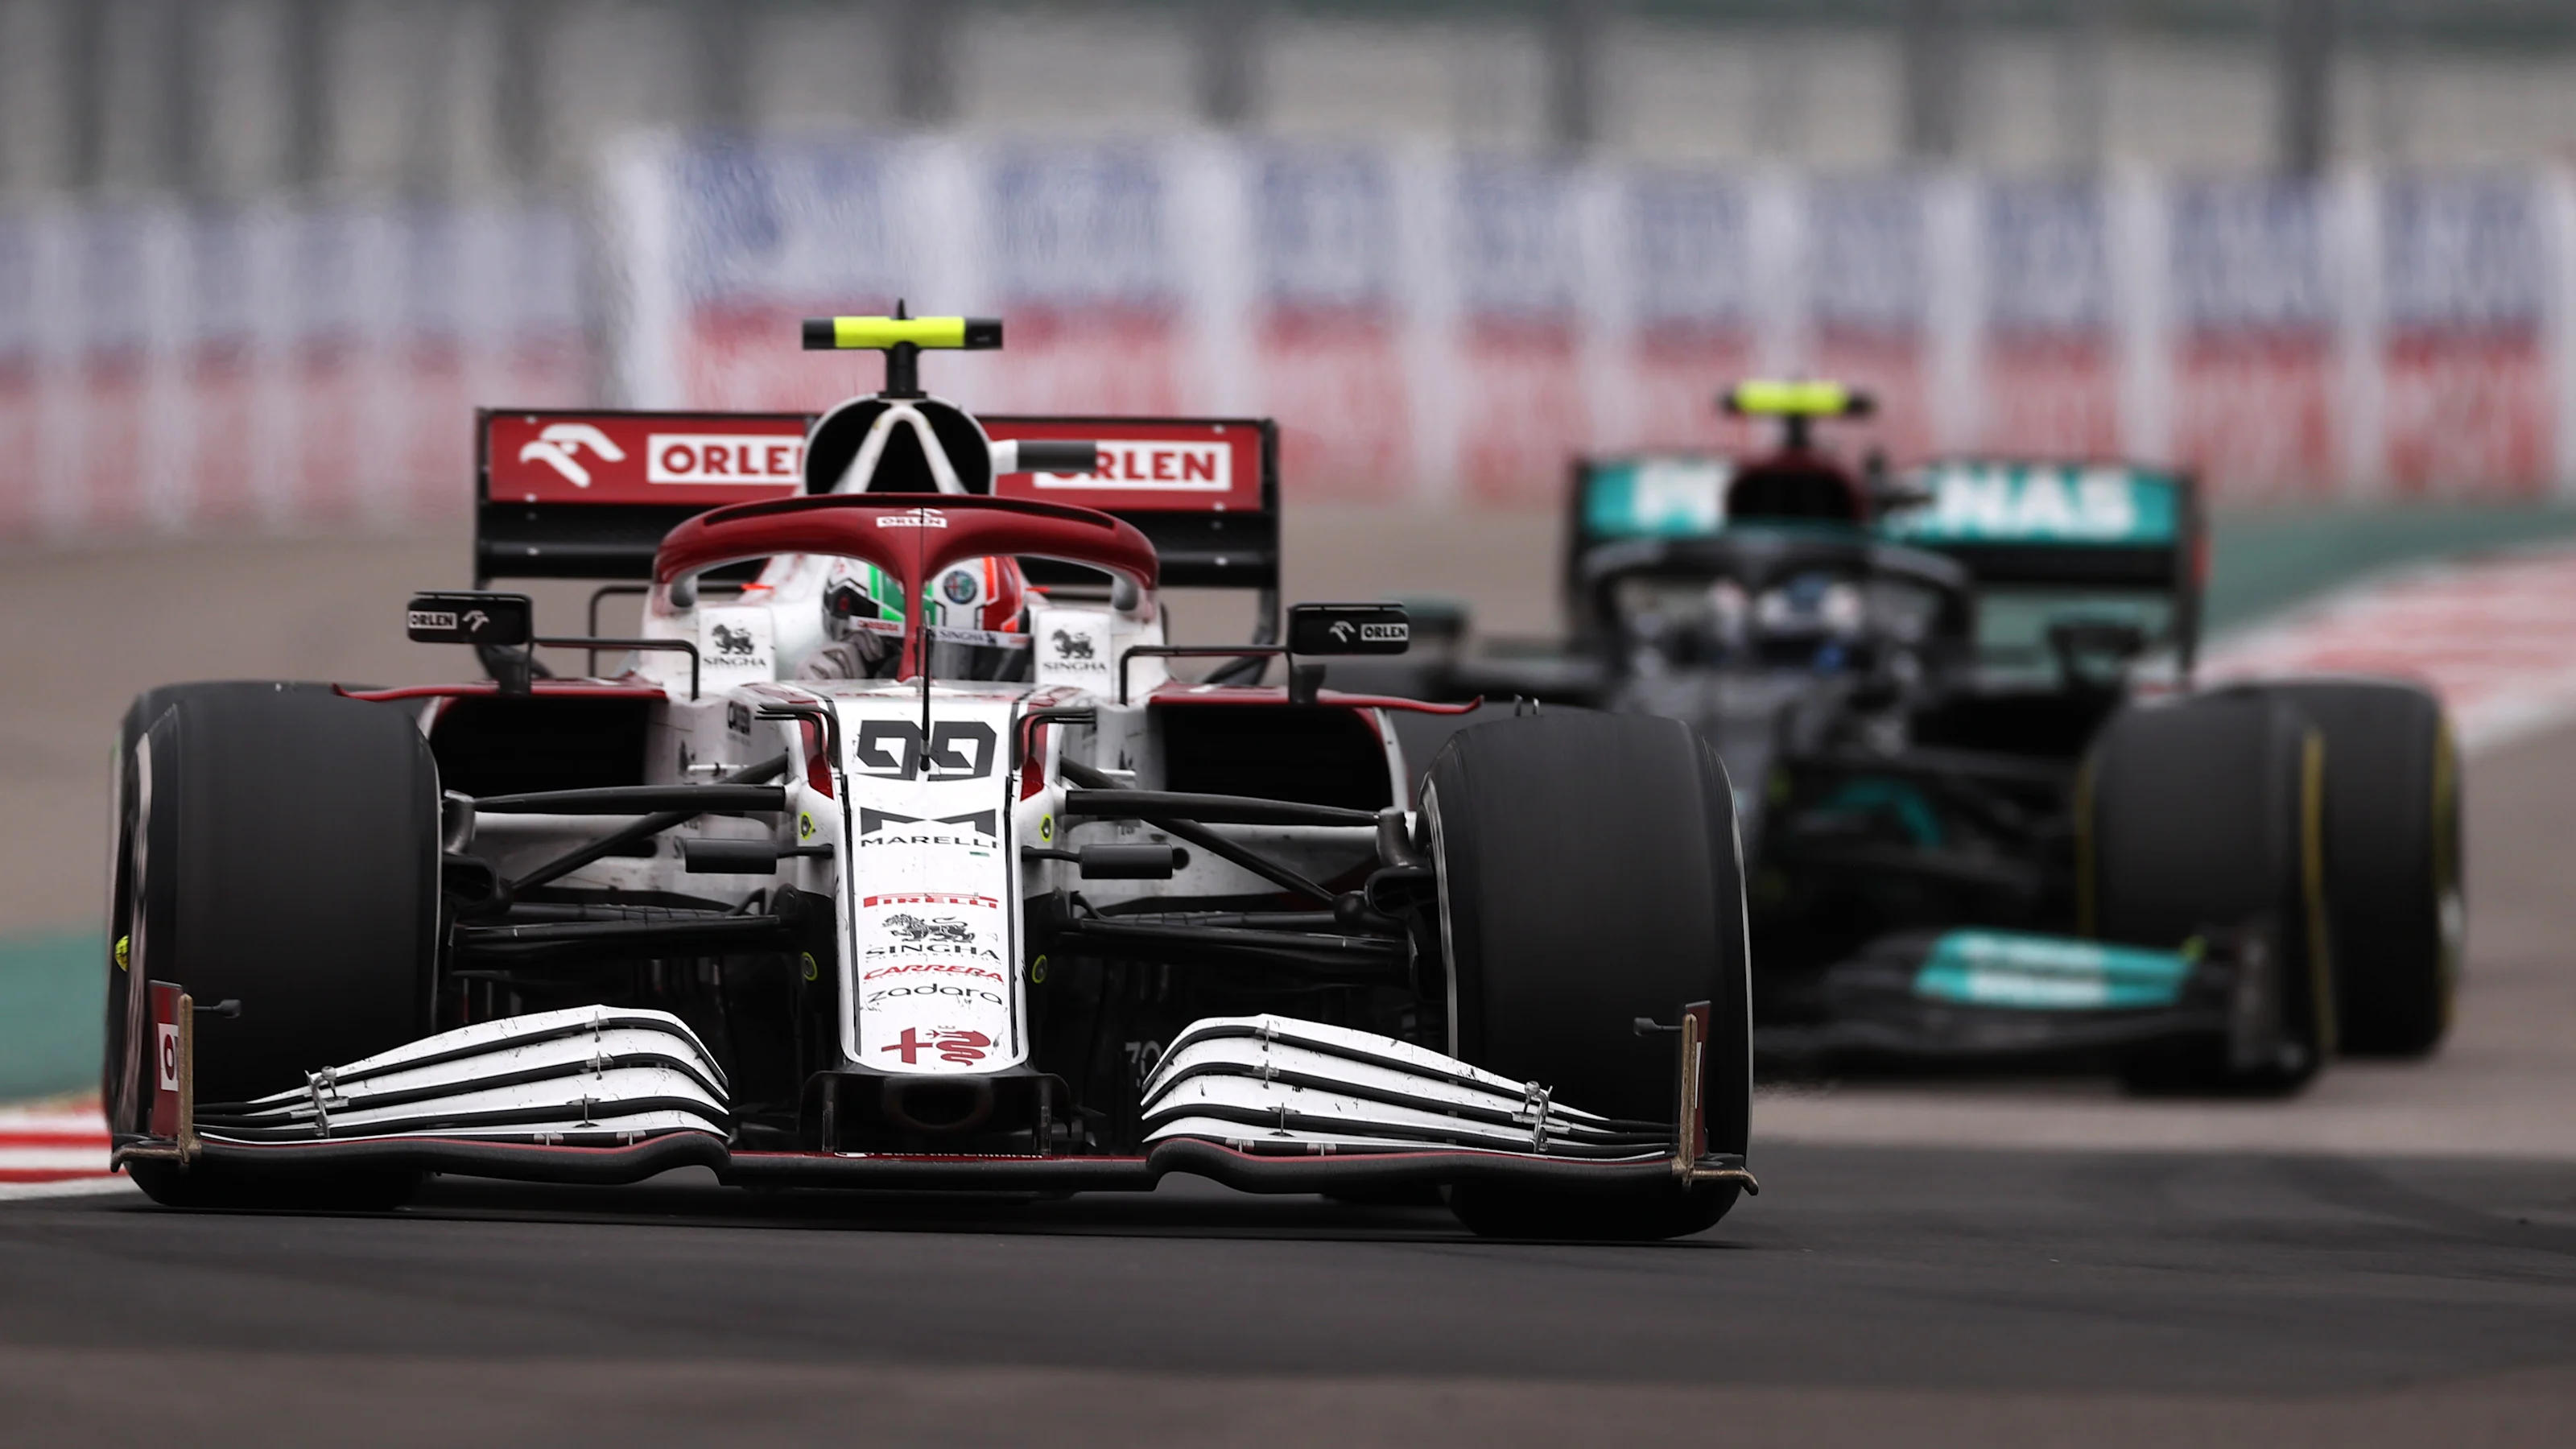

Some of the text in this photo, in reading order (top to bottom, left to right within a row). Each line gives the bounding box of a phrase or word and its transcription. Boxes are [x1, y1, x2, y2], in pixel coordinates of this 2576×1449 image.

[1051, 450, 1215, 481] RLEN
[411, 614, 453, 626] ORLEN
[1364, 625, 1407, 638] ORLEN
[703, 656, 767, 669] SINGHA
[1042, 662, 1107, 673] SINGHA
[856, 720, 997, 782] 99
[861, 836, 997, 849] MARELLI
[863, 892, 999, 909] PIRELLI
[865, 944, 1000, 961] SINGHA
[864, 964, 1005, 984] CARRERA
[867, 983, 1003, 1005] zadara
